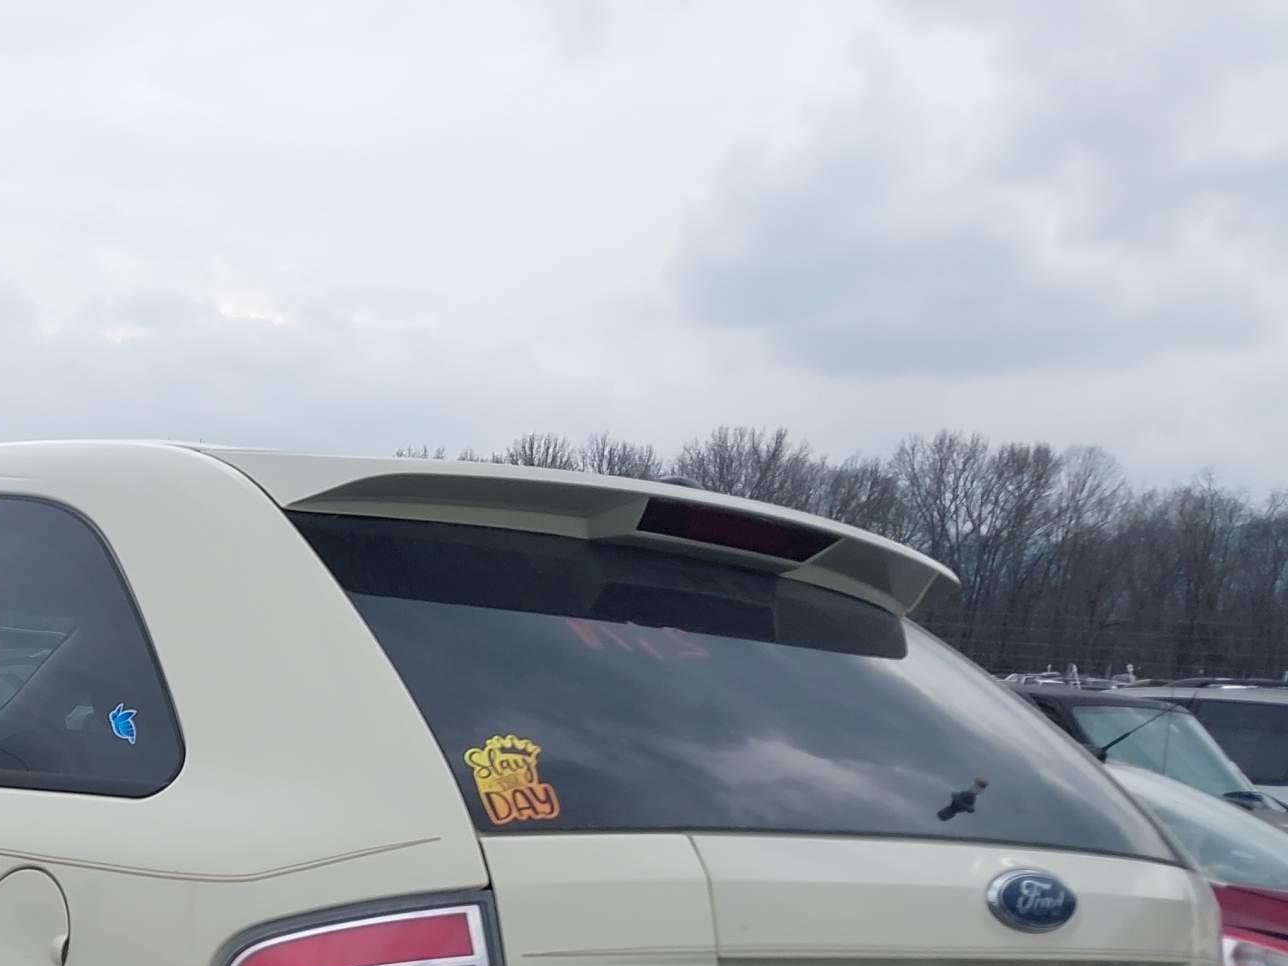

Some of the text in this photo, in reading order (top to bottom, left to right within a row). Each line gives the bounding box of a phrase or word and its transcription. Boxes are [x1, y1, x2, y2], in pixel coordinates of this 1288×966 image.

[468, 747, 534, 784] Slay
[485, 785, 555, 821] DAY
[1016, 880, 1065, 914] Ford
